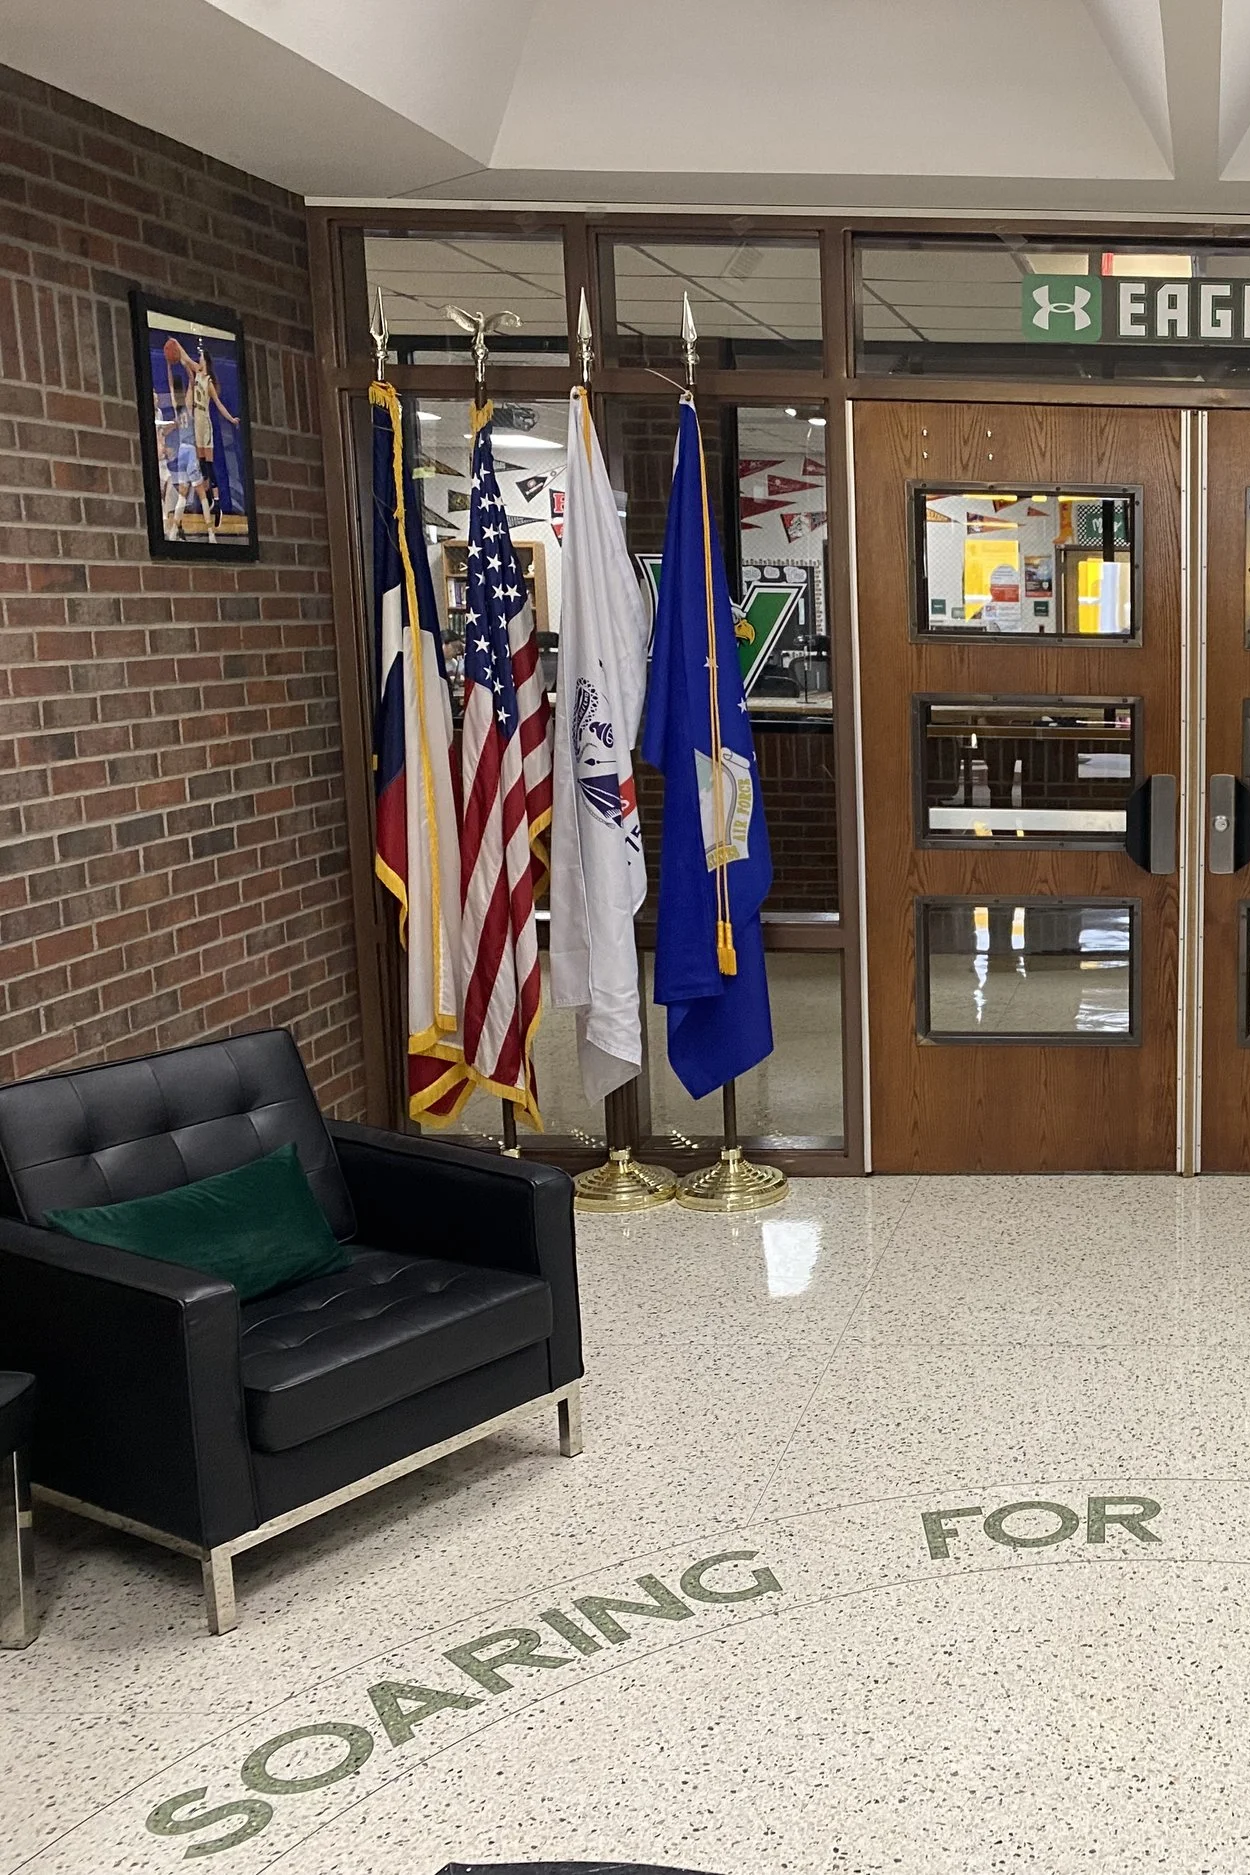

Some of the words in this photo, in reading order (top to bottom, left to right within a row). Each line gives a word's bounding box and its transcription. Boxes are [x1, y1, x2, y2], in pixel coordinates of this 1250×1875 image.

[736, 778, 752, 816] FORCE
[731, 820, 747, 842] AIR
[145, 1549, 784, 1859] SOARING
[919, 1495, 1163, 1561] FOR
